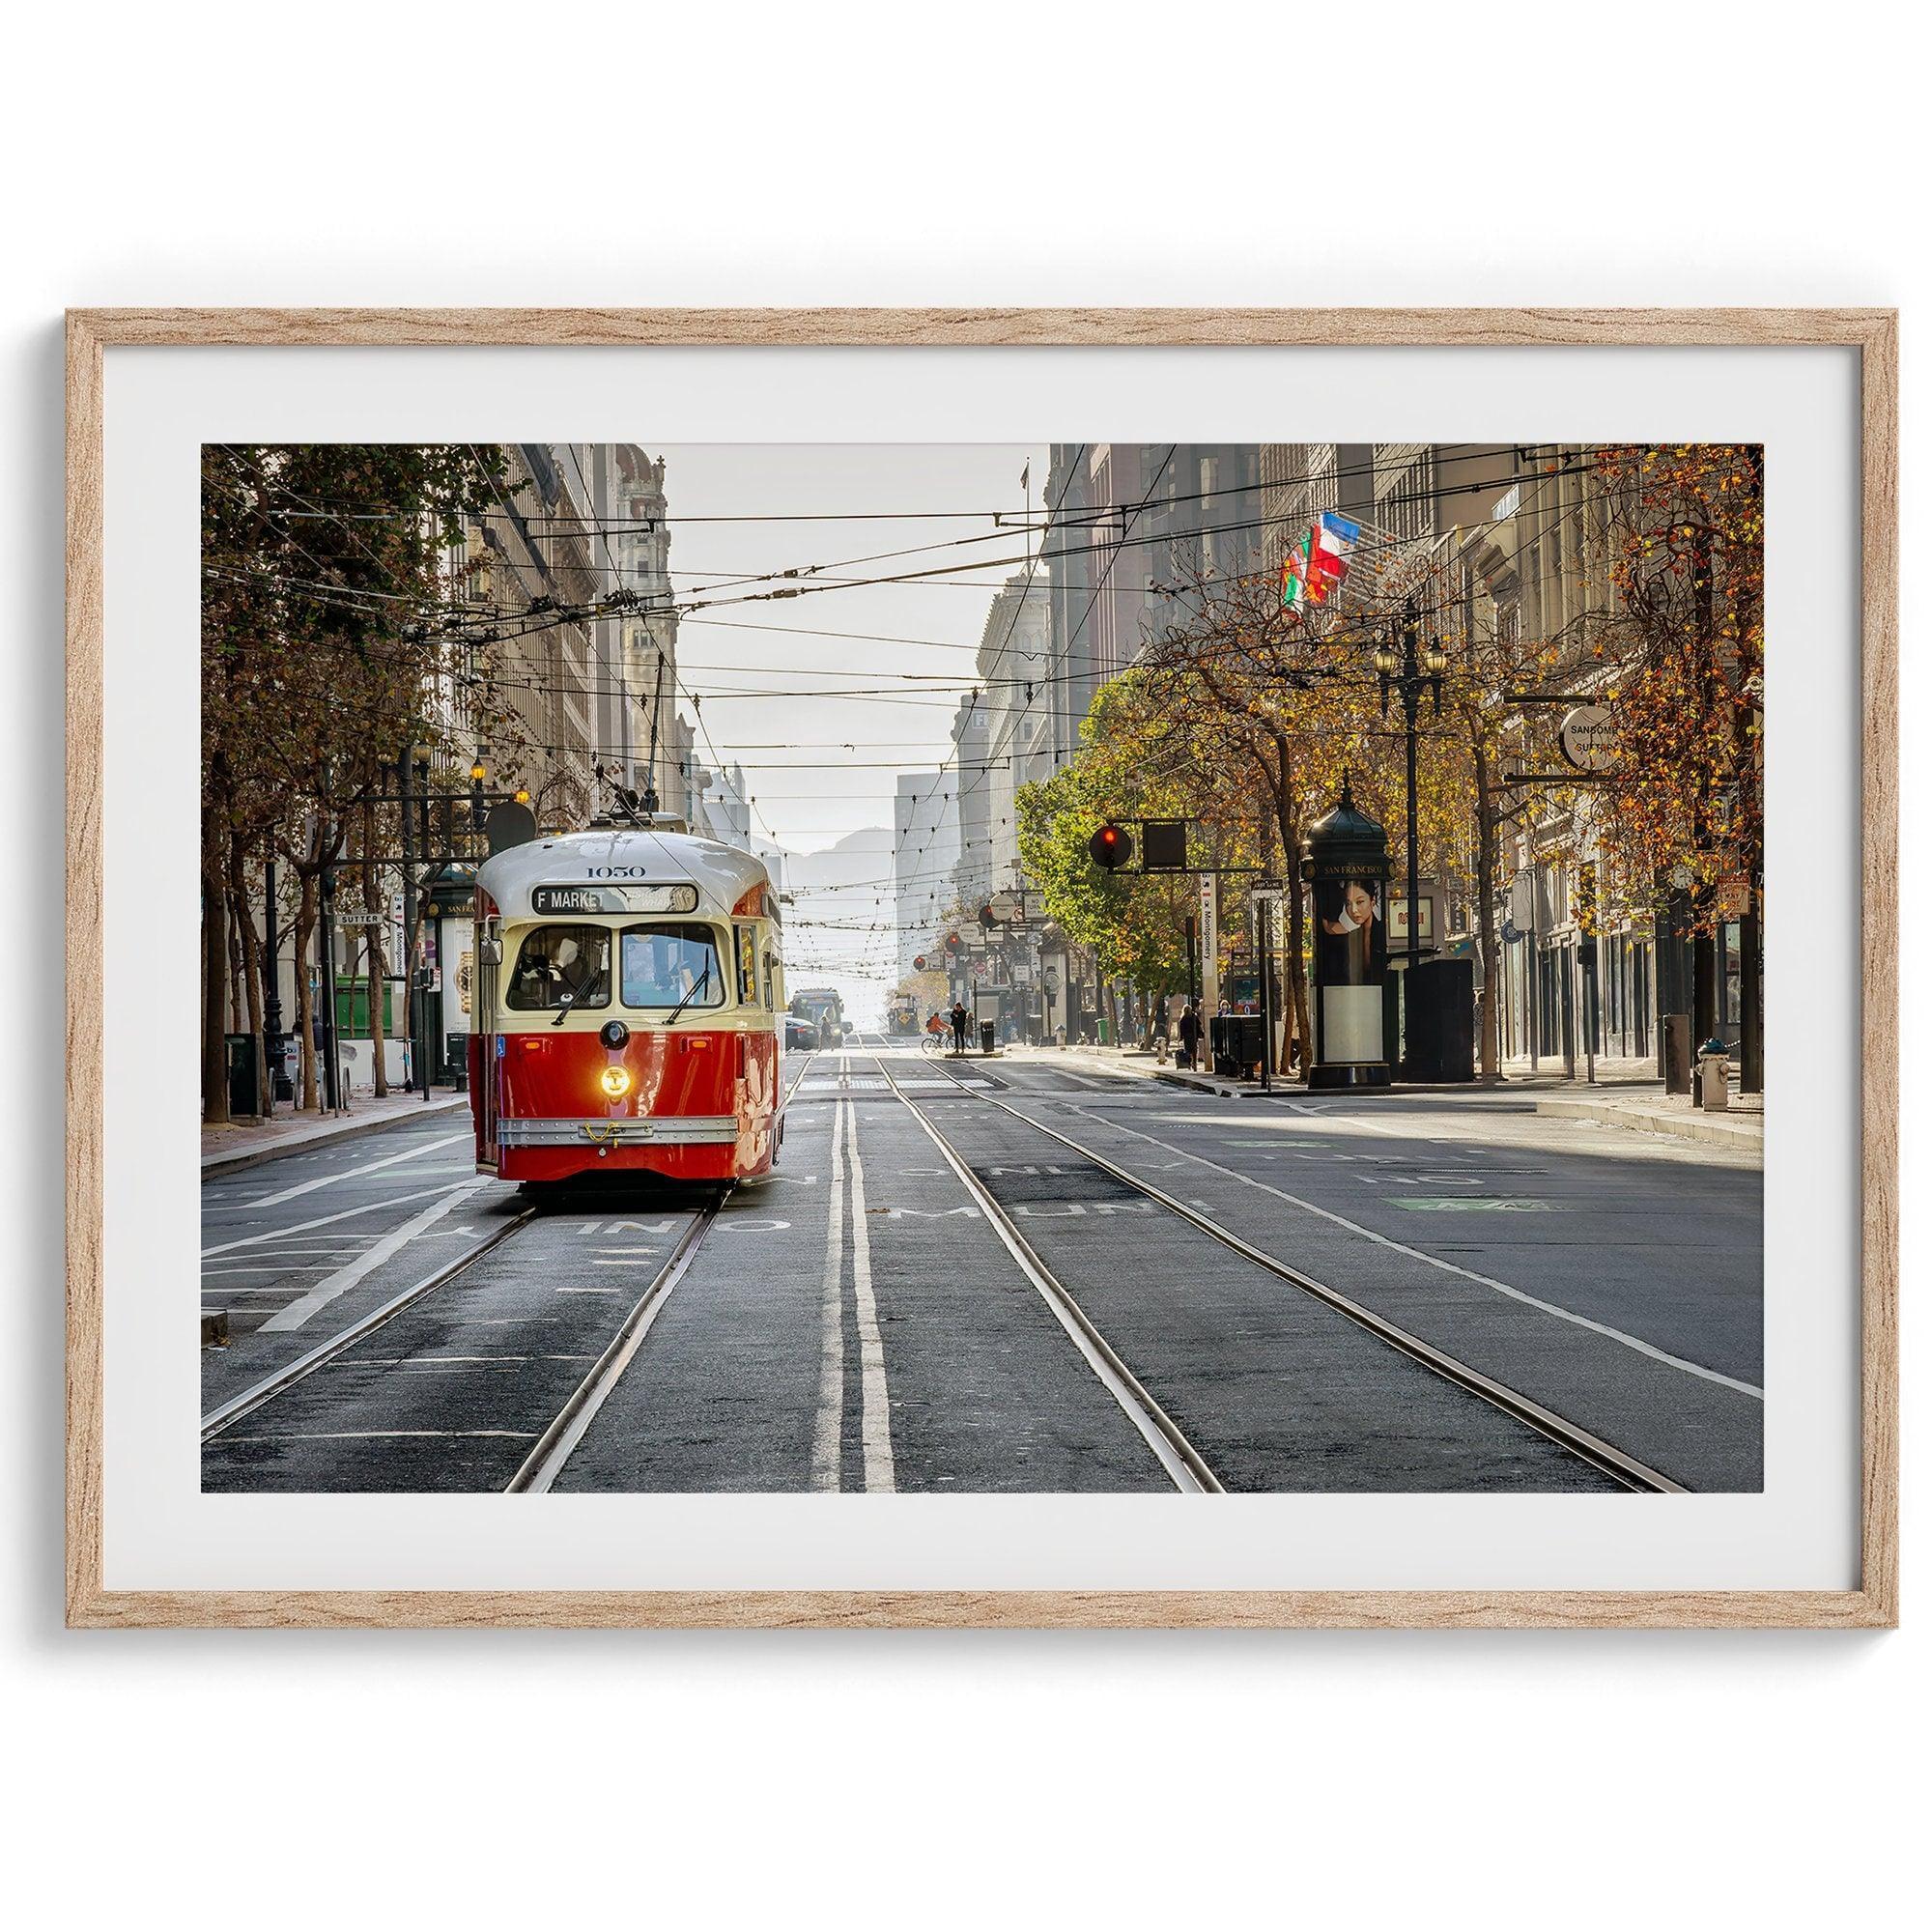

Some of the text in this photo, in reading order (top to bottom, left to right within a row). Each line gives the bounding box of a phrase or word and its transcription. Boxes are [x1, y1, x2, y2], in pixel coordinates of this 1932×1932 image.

[586, 867, 646, 878] 1050
[1324, 866, 1382, 874] SAN FRANCISCO
[538, 893, 605, 908] F MARKET
[341, 915, 378, 923] SUTTER
[1203, 911, 1211, 960] Montgomery
[887, 1199, 1218, 1219] MUNI
